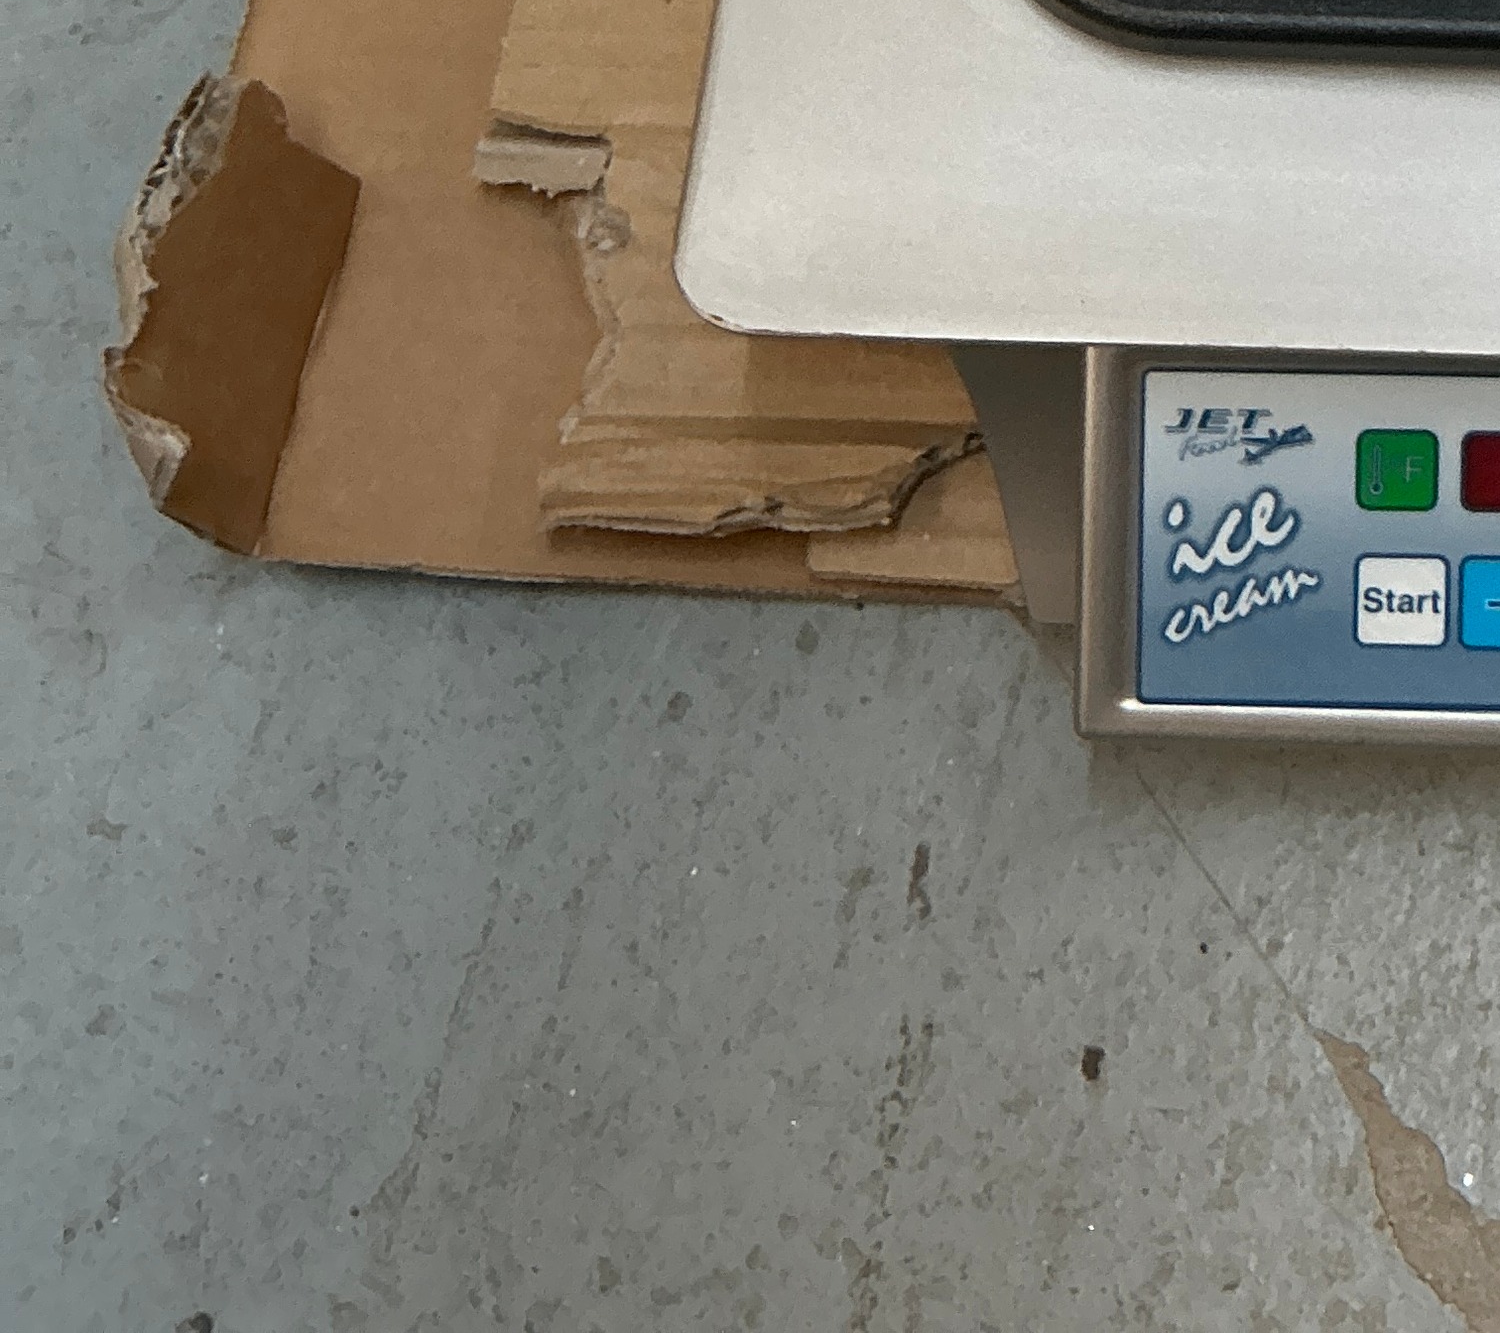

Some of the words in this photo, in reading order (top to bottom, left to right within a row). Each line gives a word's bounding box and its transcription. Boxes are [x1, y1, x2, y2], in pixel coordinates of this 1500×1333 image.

[1163, 407, 1273, 435] JET
[1167, 489, 1296, 575] ice
[1163, 569, 1320, 643] cream
[1362, 586, 1441, 615] Start
